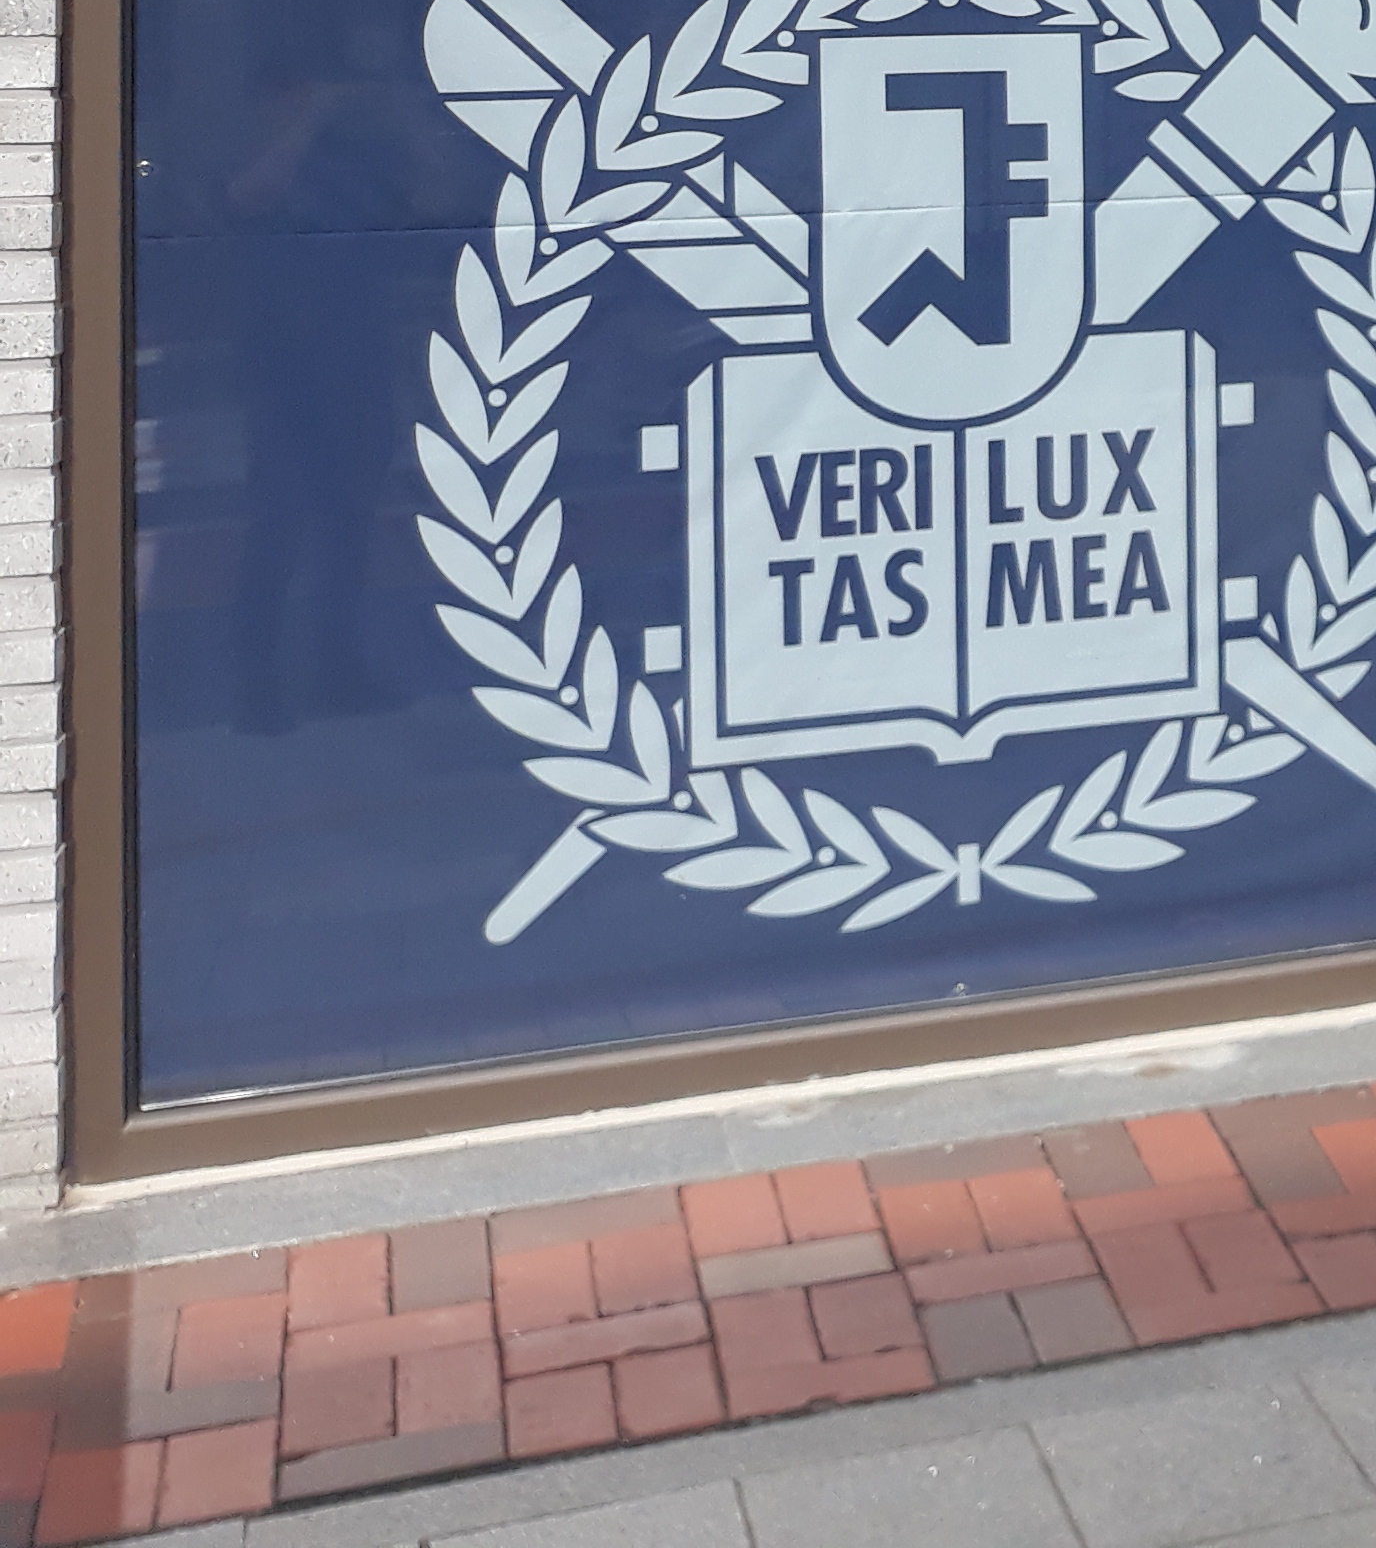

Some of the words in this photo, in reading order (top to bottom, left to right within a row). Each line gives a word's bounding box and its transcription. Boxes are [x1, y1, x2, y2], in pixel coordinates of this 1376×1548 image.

[753, 443, 934, 542] VERI
[986, 427, 1158, 525] LUX
[767, 547, 930, 648] TAS
[984, 528, 1172, 629] MEA
